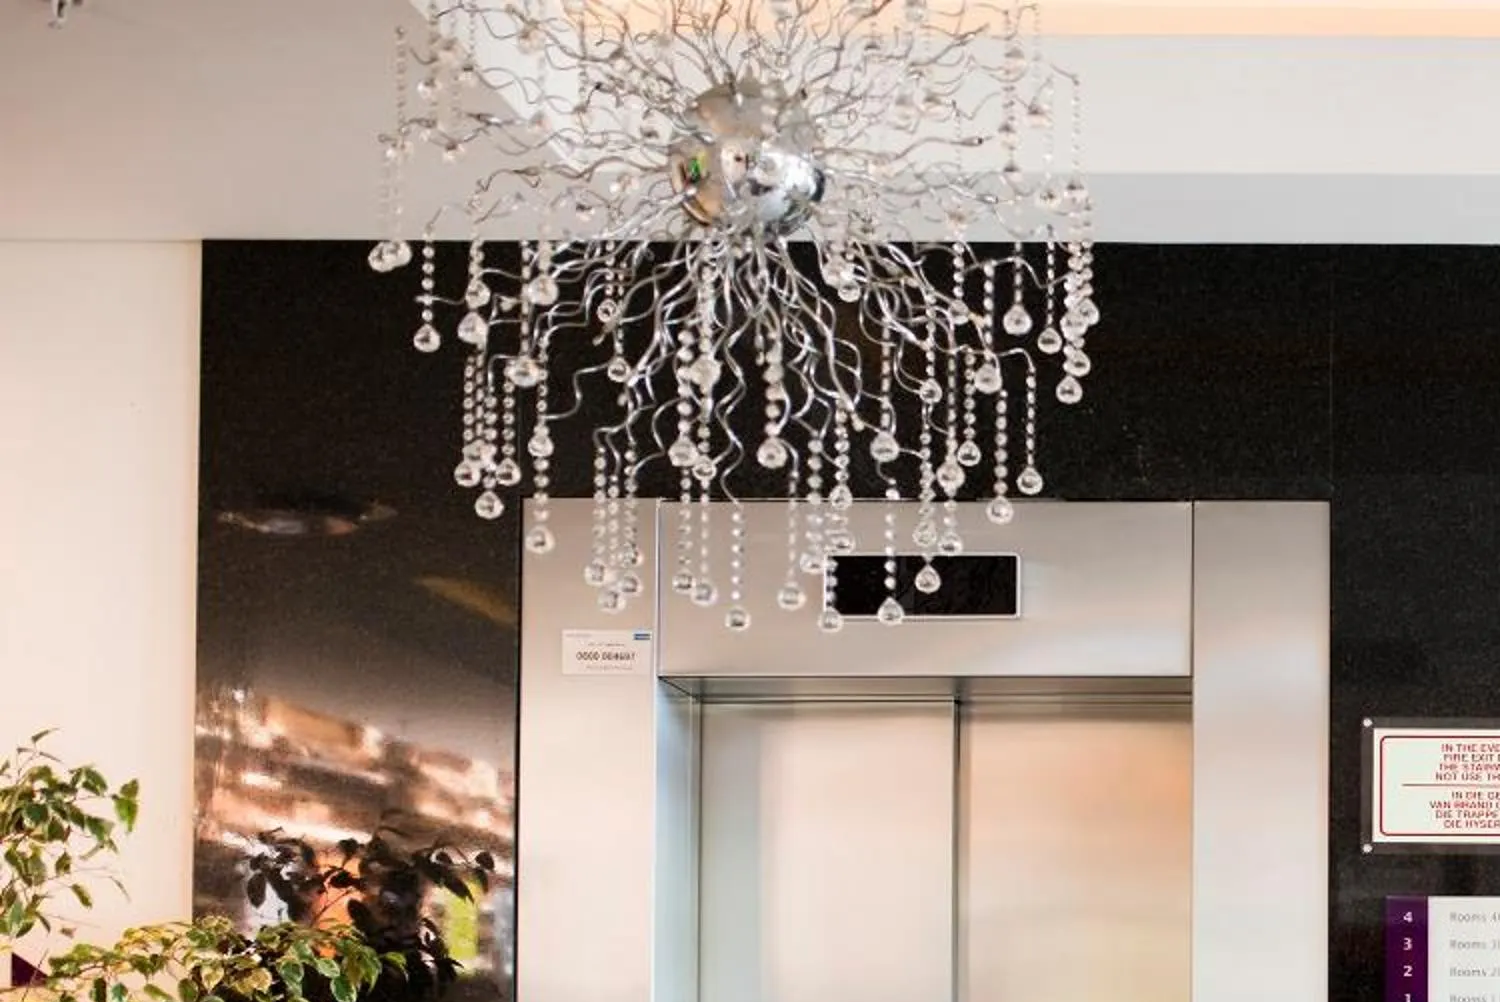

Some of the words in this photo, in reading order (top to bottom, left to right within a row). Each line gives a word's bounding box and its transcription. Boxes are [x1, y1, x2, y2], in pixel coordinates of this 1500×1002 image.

[1440, 744, 1454, 753] IN
[1456, 744, 1477, 753] THE
[1444, 753, 1468, 762] FIRE
[1472, 753, 1494, 762] EXIT
[1439, 763, 1458, 772] THE
[1435, 772, 1458, 782] NOT
[1460, 772, 1482, 782] USE
[1451, 791, 1463, 800] IN
[1465, 791, 1484, 800] DIE
[1429, 800, 1451, 809] VAN
[1454, 800, 1493, 809] BRAND
[1435, 810, 1453, 818] DIE
[1444, 820, 1462, 828] DIE
[1403, 912, 1413, 923] 4
[1449, 912, 1487, 922] Rooms
[1403, 938, 1413, 950] 3
[1449, 939, 1487, 950] Rooms
[1403, 965, 1413, 977] 2
[1449, 966, 1487, 978] Rooms
